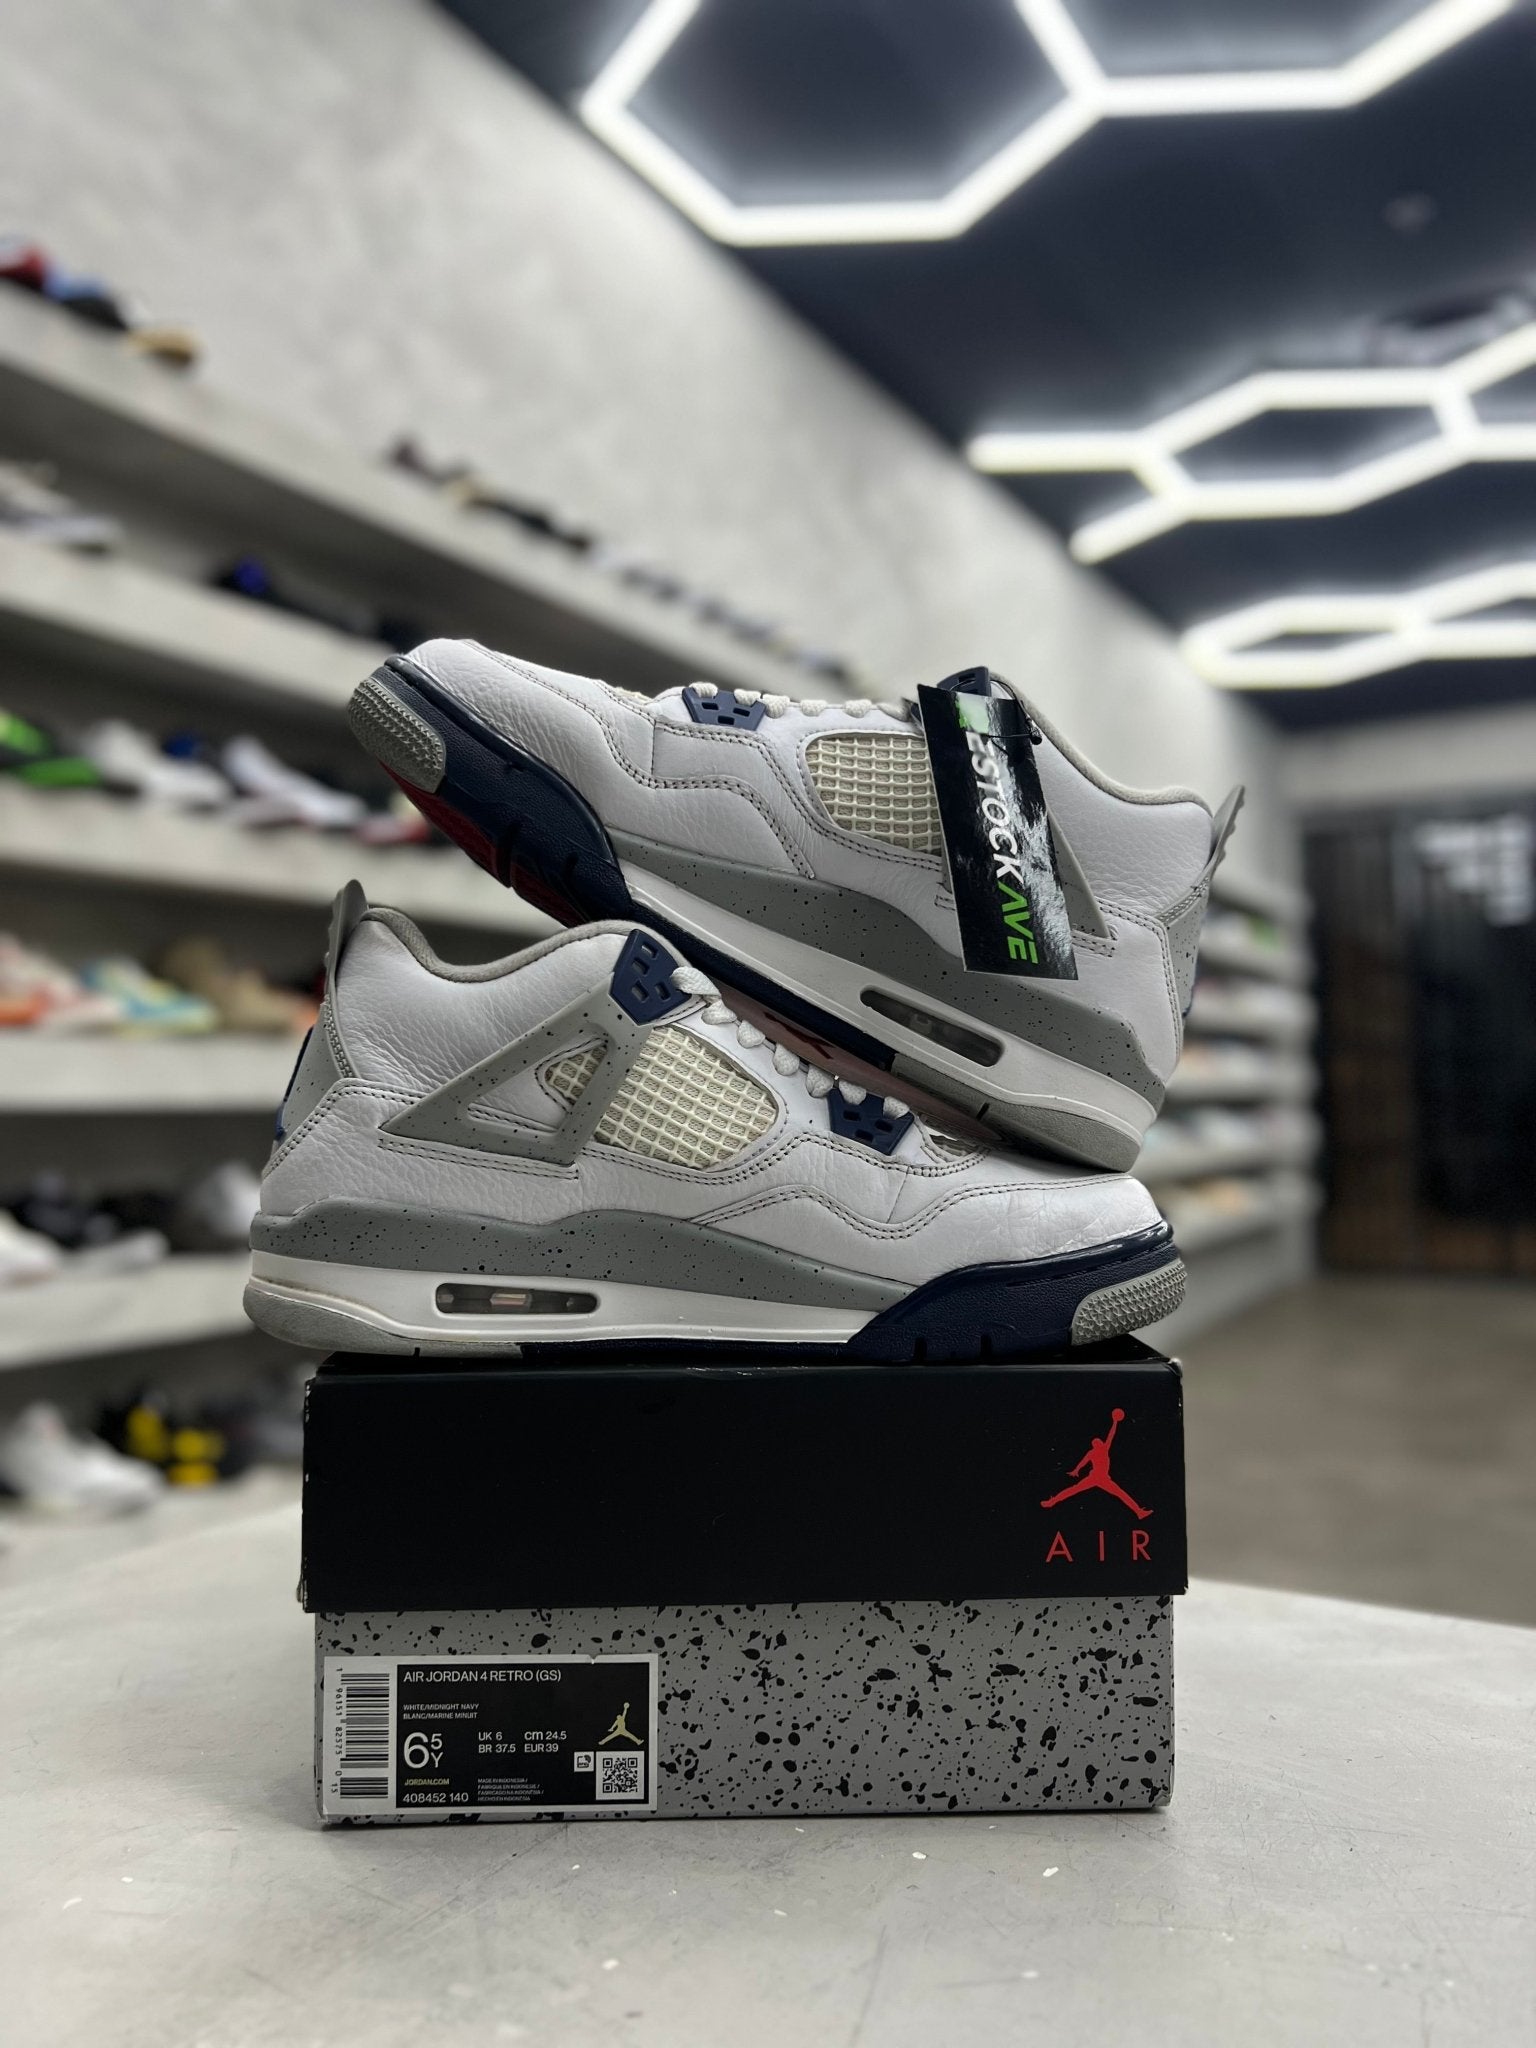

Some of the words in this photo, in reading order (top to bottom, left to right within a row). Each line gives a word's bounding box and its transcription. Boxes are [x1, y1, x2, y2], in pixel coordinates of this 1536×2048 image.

[1045, 1529, 1152, 1563] AIR
[403, 1671, 424, 1683] AIR
[426, 1671, 478, 1683] JORDAN
[480, 1671, 488, 1682] 4
[490, 1670, 533, 1682] RETRO
[536, 1669, 562, 1683] (GS)
[335, 1687, 343, 1716] 96151
[335, 1726, 343, 1755] 82575
[430, 1733, 443, 1750] 5
[478, 1731, 492, 1741] UK
[495, 1731, 503, 1741] 6
[524, 1731, 543, 1741] cm
[546, 1731, 567, 1741] 24.5
[403, 1732, 430, 1769] 6
[478, 1744, 492, 1754] BR
[495, 1743, 516, 1753] 37.5
[524, 1743, 544, 1753] EUR
[546, 1743, 559, 1753] 39
[430, 1751, 443, 1768] Y
[404, 1778, 450, 1786] JORDAN.COM
[403, 1792, 446, 1803] 408452
[450, 1792, 469, 1802] 140
